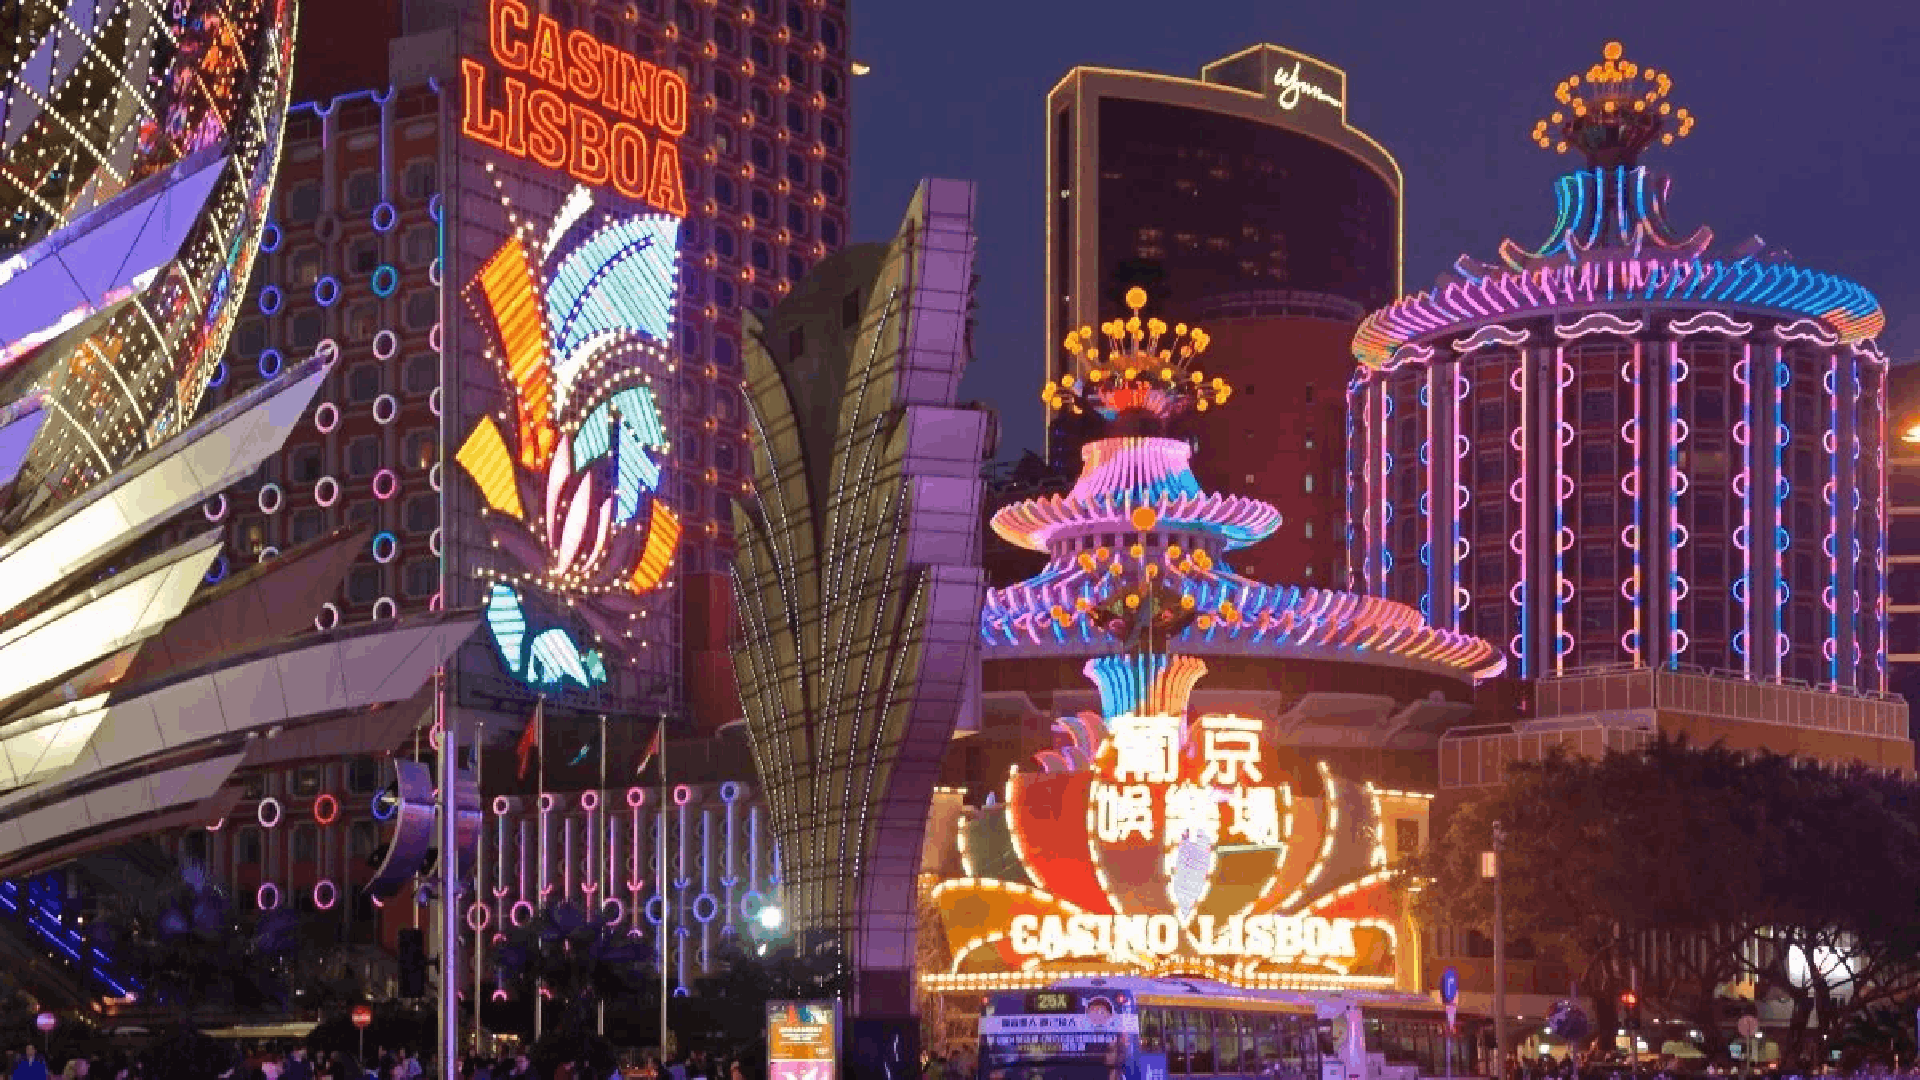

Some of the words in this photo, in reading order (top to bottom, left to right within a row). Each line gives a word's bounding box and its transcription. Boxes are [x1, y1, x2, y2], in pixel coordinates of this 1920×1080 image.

[489, 0, 687, 137] CASINO
[461, 58, 687, 218] LISBOA
[1110, 713, 1263, 786] 葡京
[1010, 914, 1179, 957] CASINO
[1196, 914, 1356, 957] LISBOA
